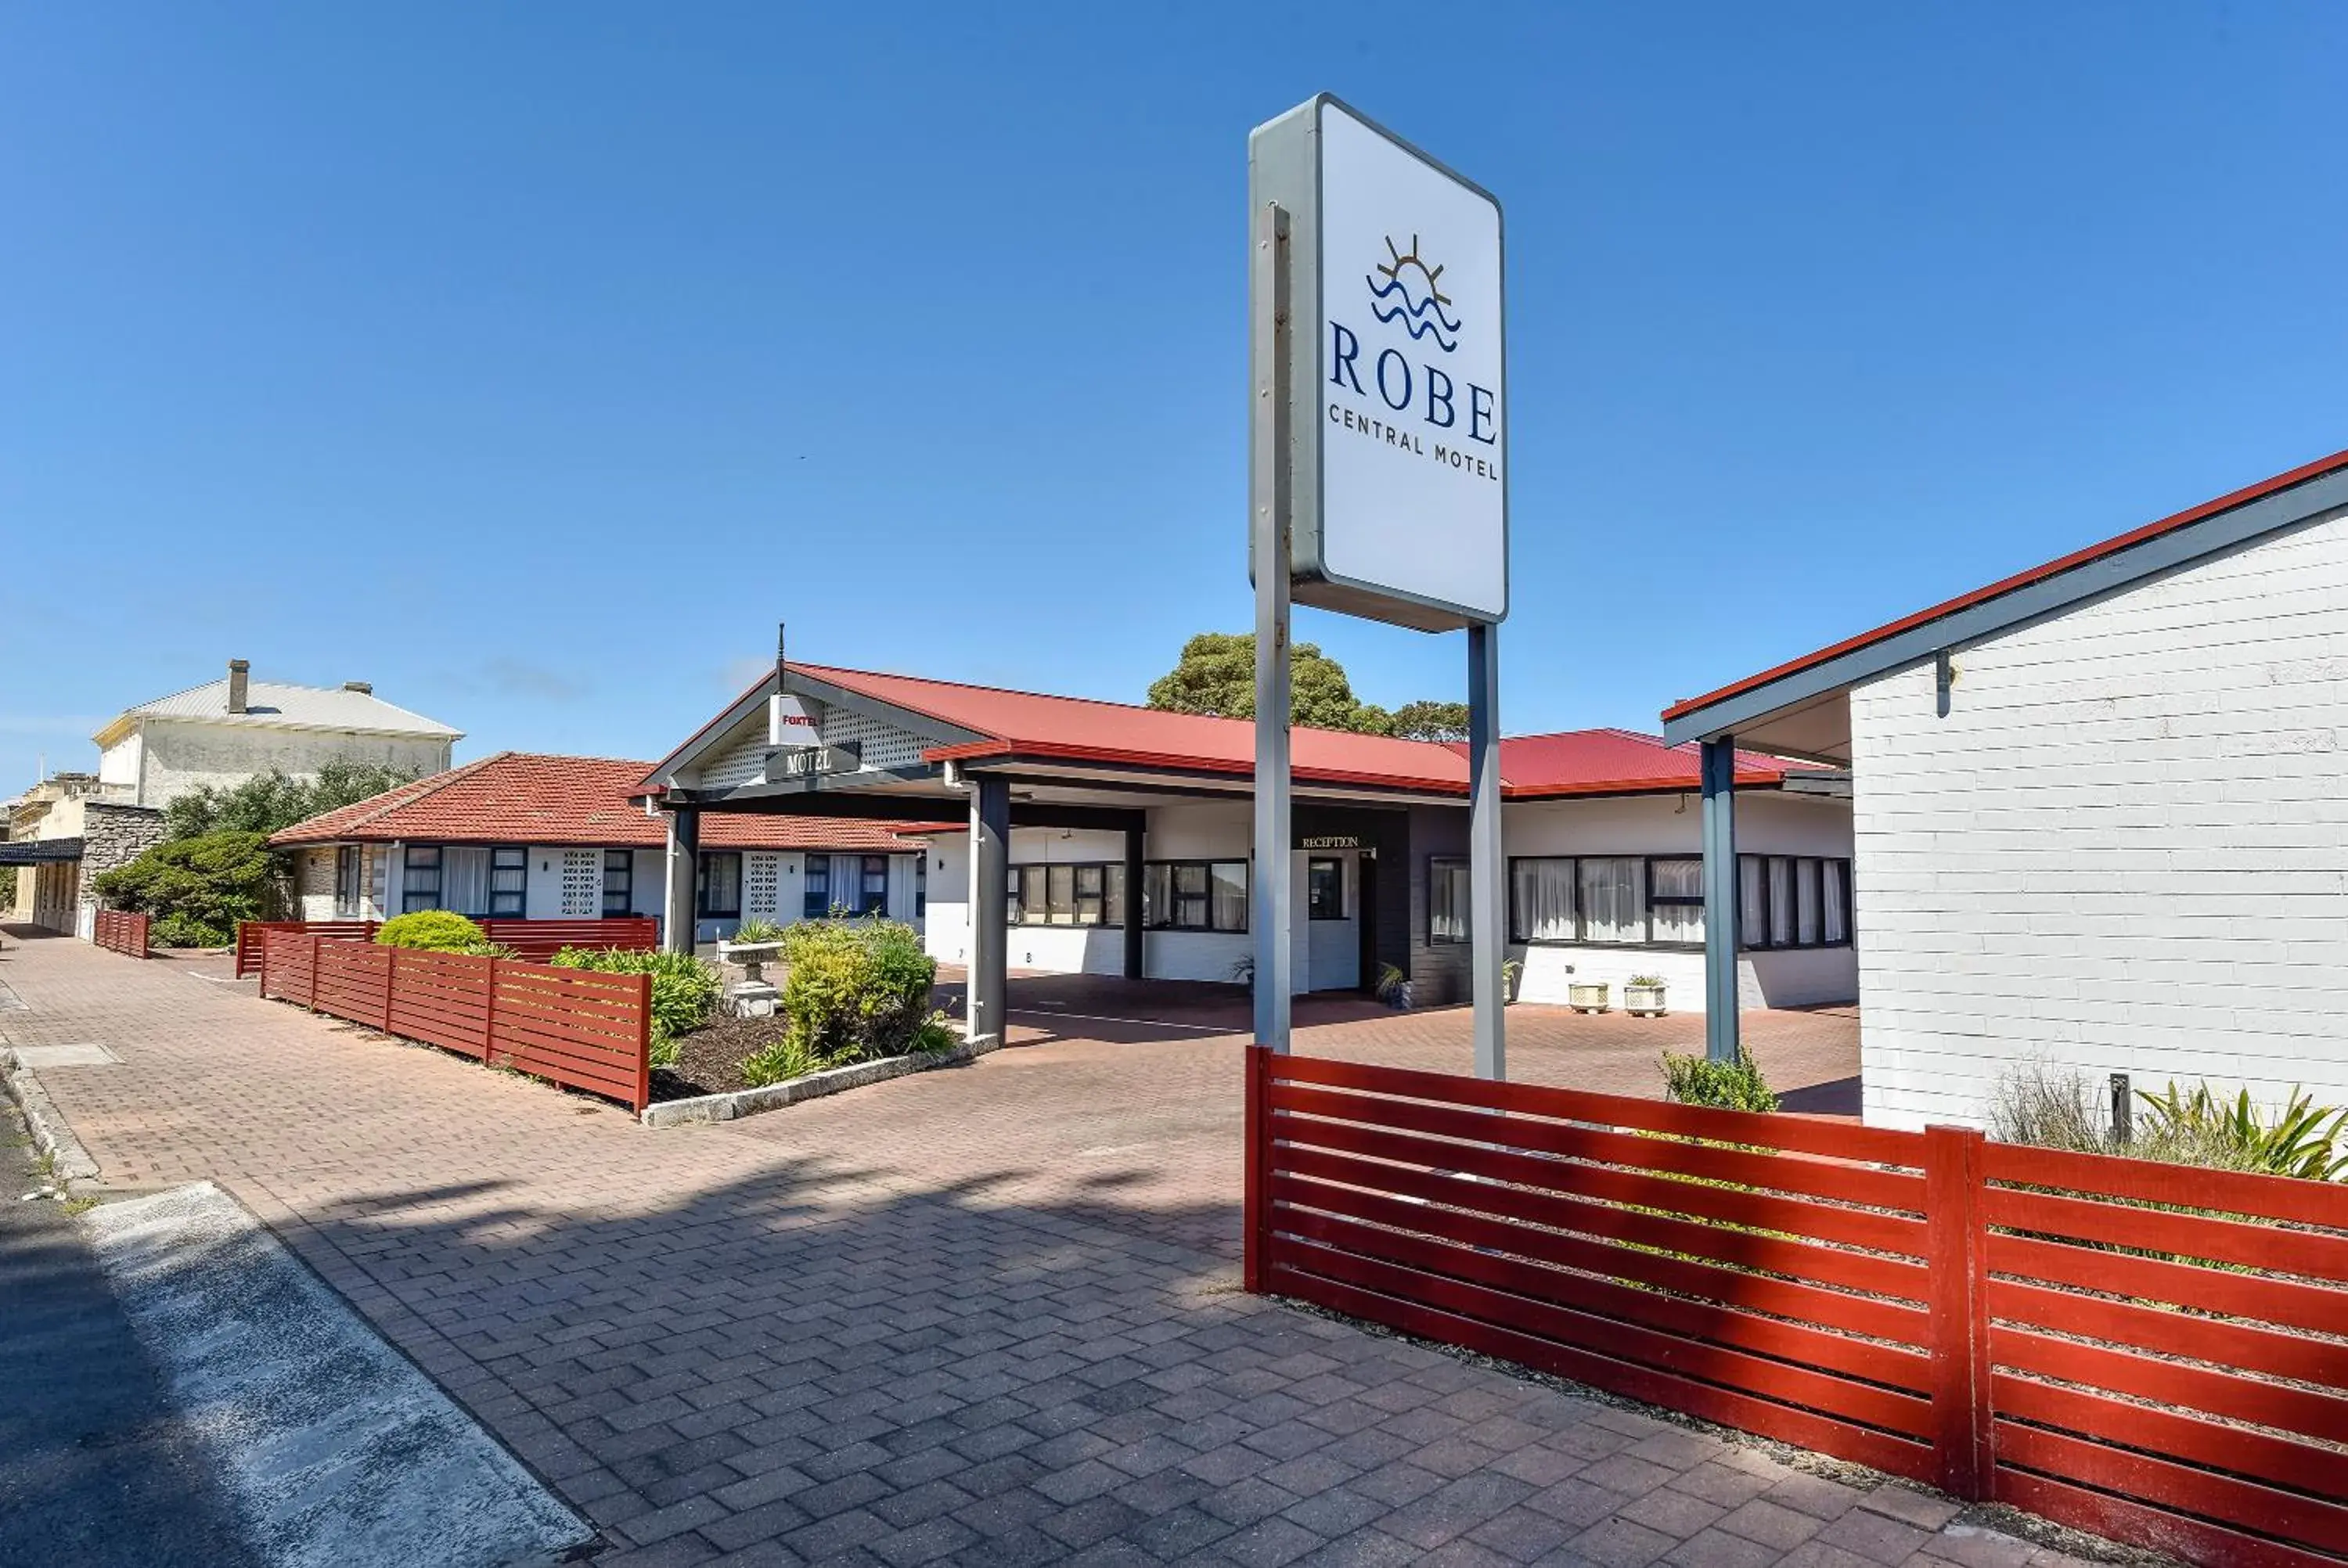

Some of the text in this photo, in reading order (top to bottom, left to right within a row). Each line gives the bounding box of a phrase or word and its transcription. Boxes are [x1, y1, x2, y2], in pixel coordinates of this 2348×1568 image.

[1328, 320, 1496, 445] ROBE
[1330, 404, 1497, 481] CENTRAL MOTEL
[783, 714, 818, 727] FOXTEL
[787, 750, 832, 774] MOTEL
[1302, 836, 1359, 848] RECEPTION
